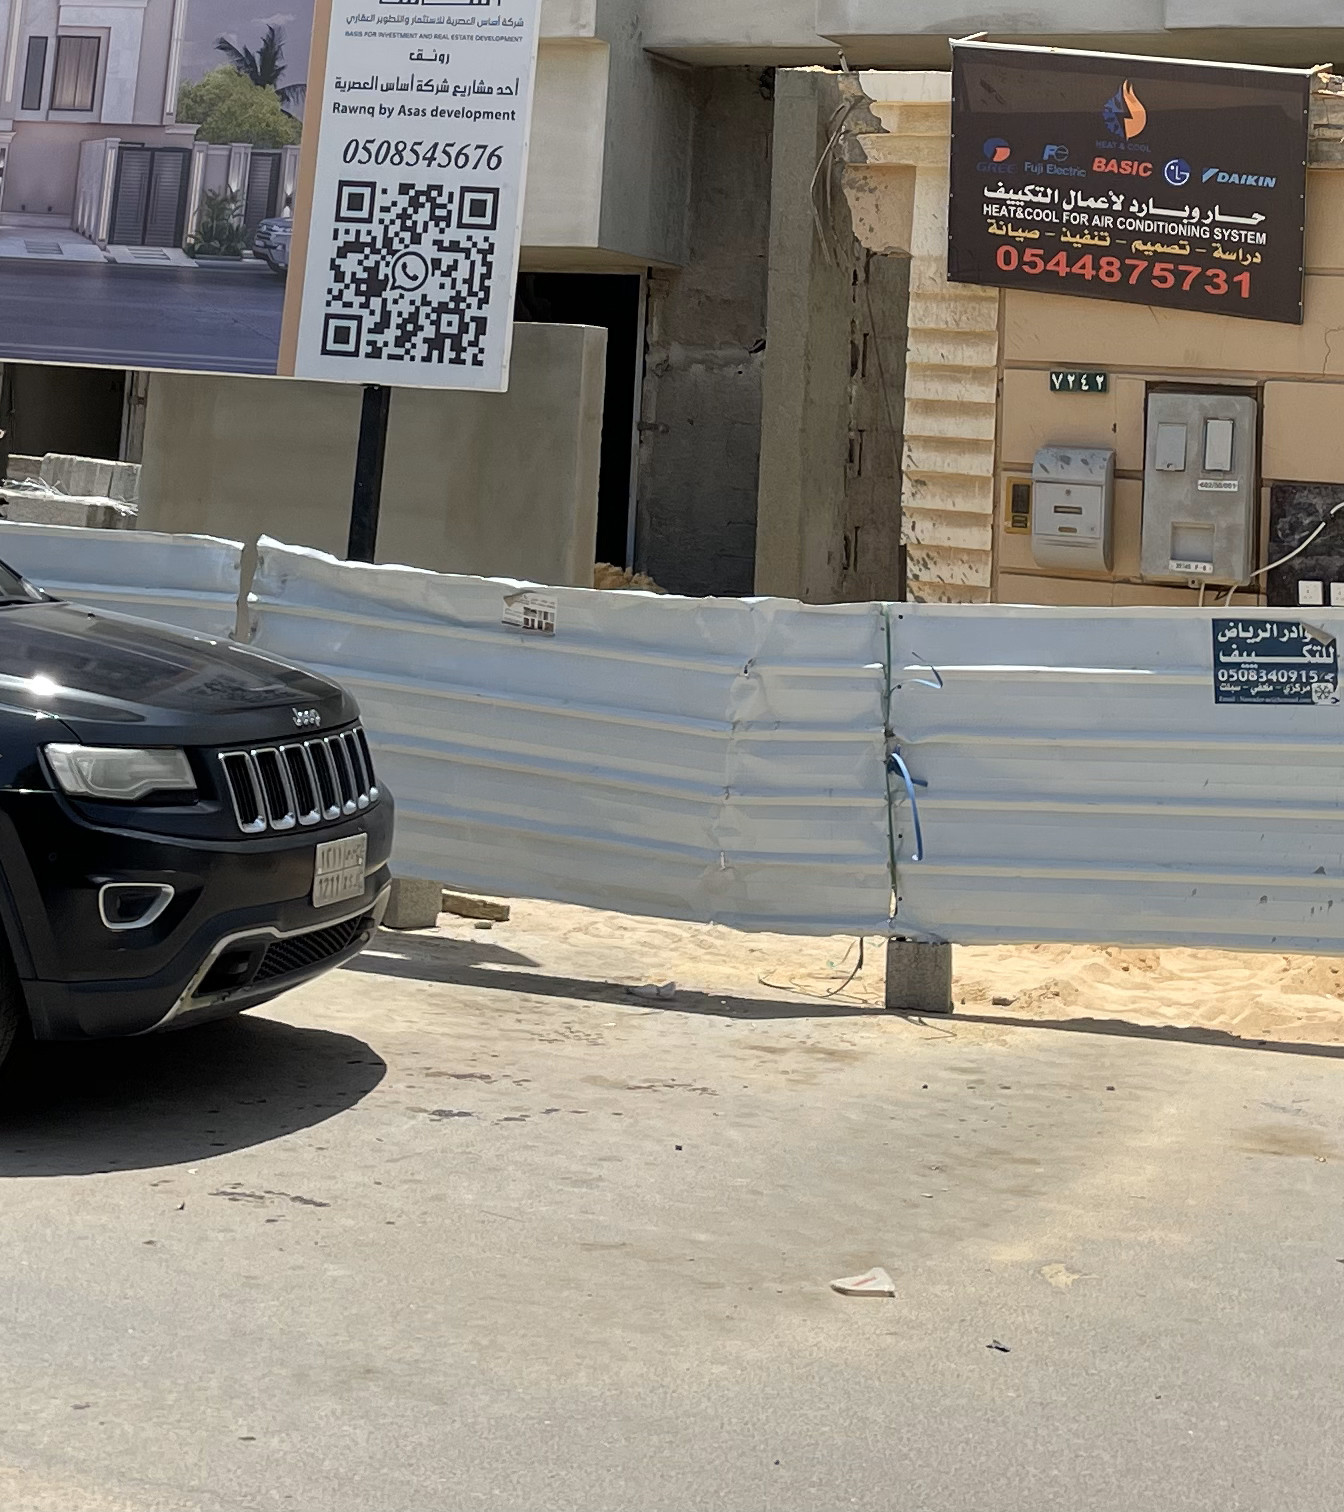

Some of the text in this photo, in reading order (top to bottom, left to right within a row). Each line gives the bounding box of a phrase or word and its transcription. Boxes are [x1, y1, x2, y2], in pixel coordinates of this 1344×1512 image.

[501, 16, 524, 29] شركة
[378, 31, 417, 40] INVESTMENT
[419, 32, 432, 40] AND
[433, 32, 449, 41] REAL
[450, 33, 474, 42] ESTATE
[474, 34, 523, 43] DEVELOPMENT
[334, 73, 520, 97] أحد مشاريع شركة أساس العصرية
[332, 101, 516, 122] Rawnq by Asas development
[342, 138, 505, 171] 0508545676
[1095, 139, 1118, 151] HEAT
[1127, 142, 1151, 153] COOL
[976, 161, 1016, 175] GREE
[1024, 161, 1087, 178] Fuji Electric
[1092, 156, 1153, 178] BASIC
[1216, 171, 1277, 189] DAIKIN
[983, 181, 1059, 206] التكييف
[1062, 190, 1125, 211] لأعمال
[982, 203, 1267, 246] HEAT&COOL FOR AIR CONDITIONING SYSTEM
[986, 218, 1041, 243] صيانة
[1060, 227, 1111, 248] تنفيذ
[1131, 239, 1191, 256] تصميم
[1211, 242, 1262, 266] دراسة
[996, 244, 1251, 299] 0544875731
[1217, 621, 1313, 644] وادر الرياض
[1219, 643, 1335, 669] للتكييف
[1217, 668, 1319, 684] 0508340915
[1282, 682, 1311, 696] مركزي
[292, 707, 321, 727] Jeep
